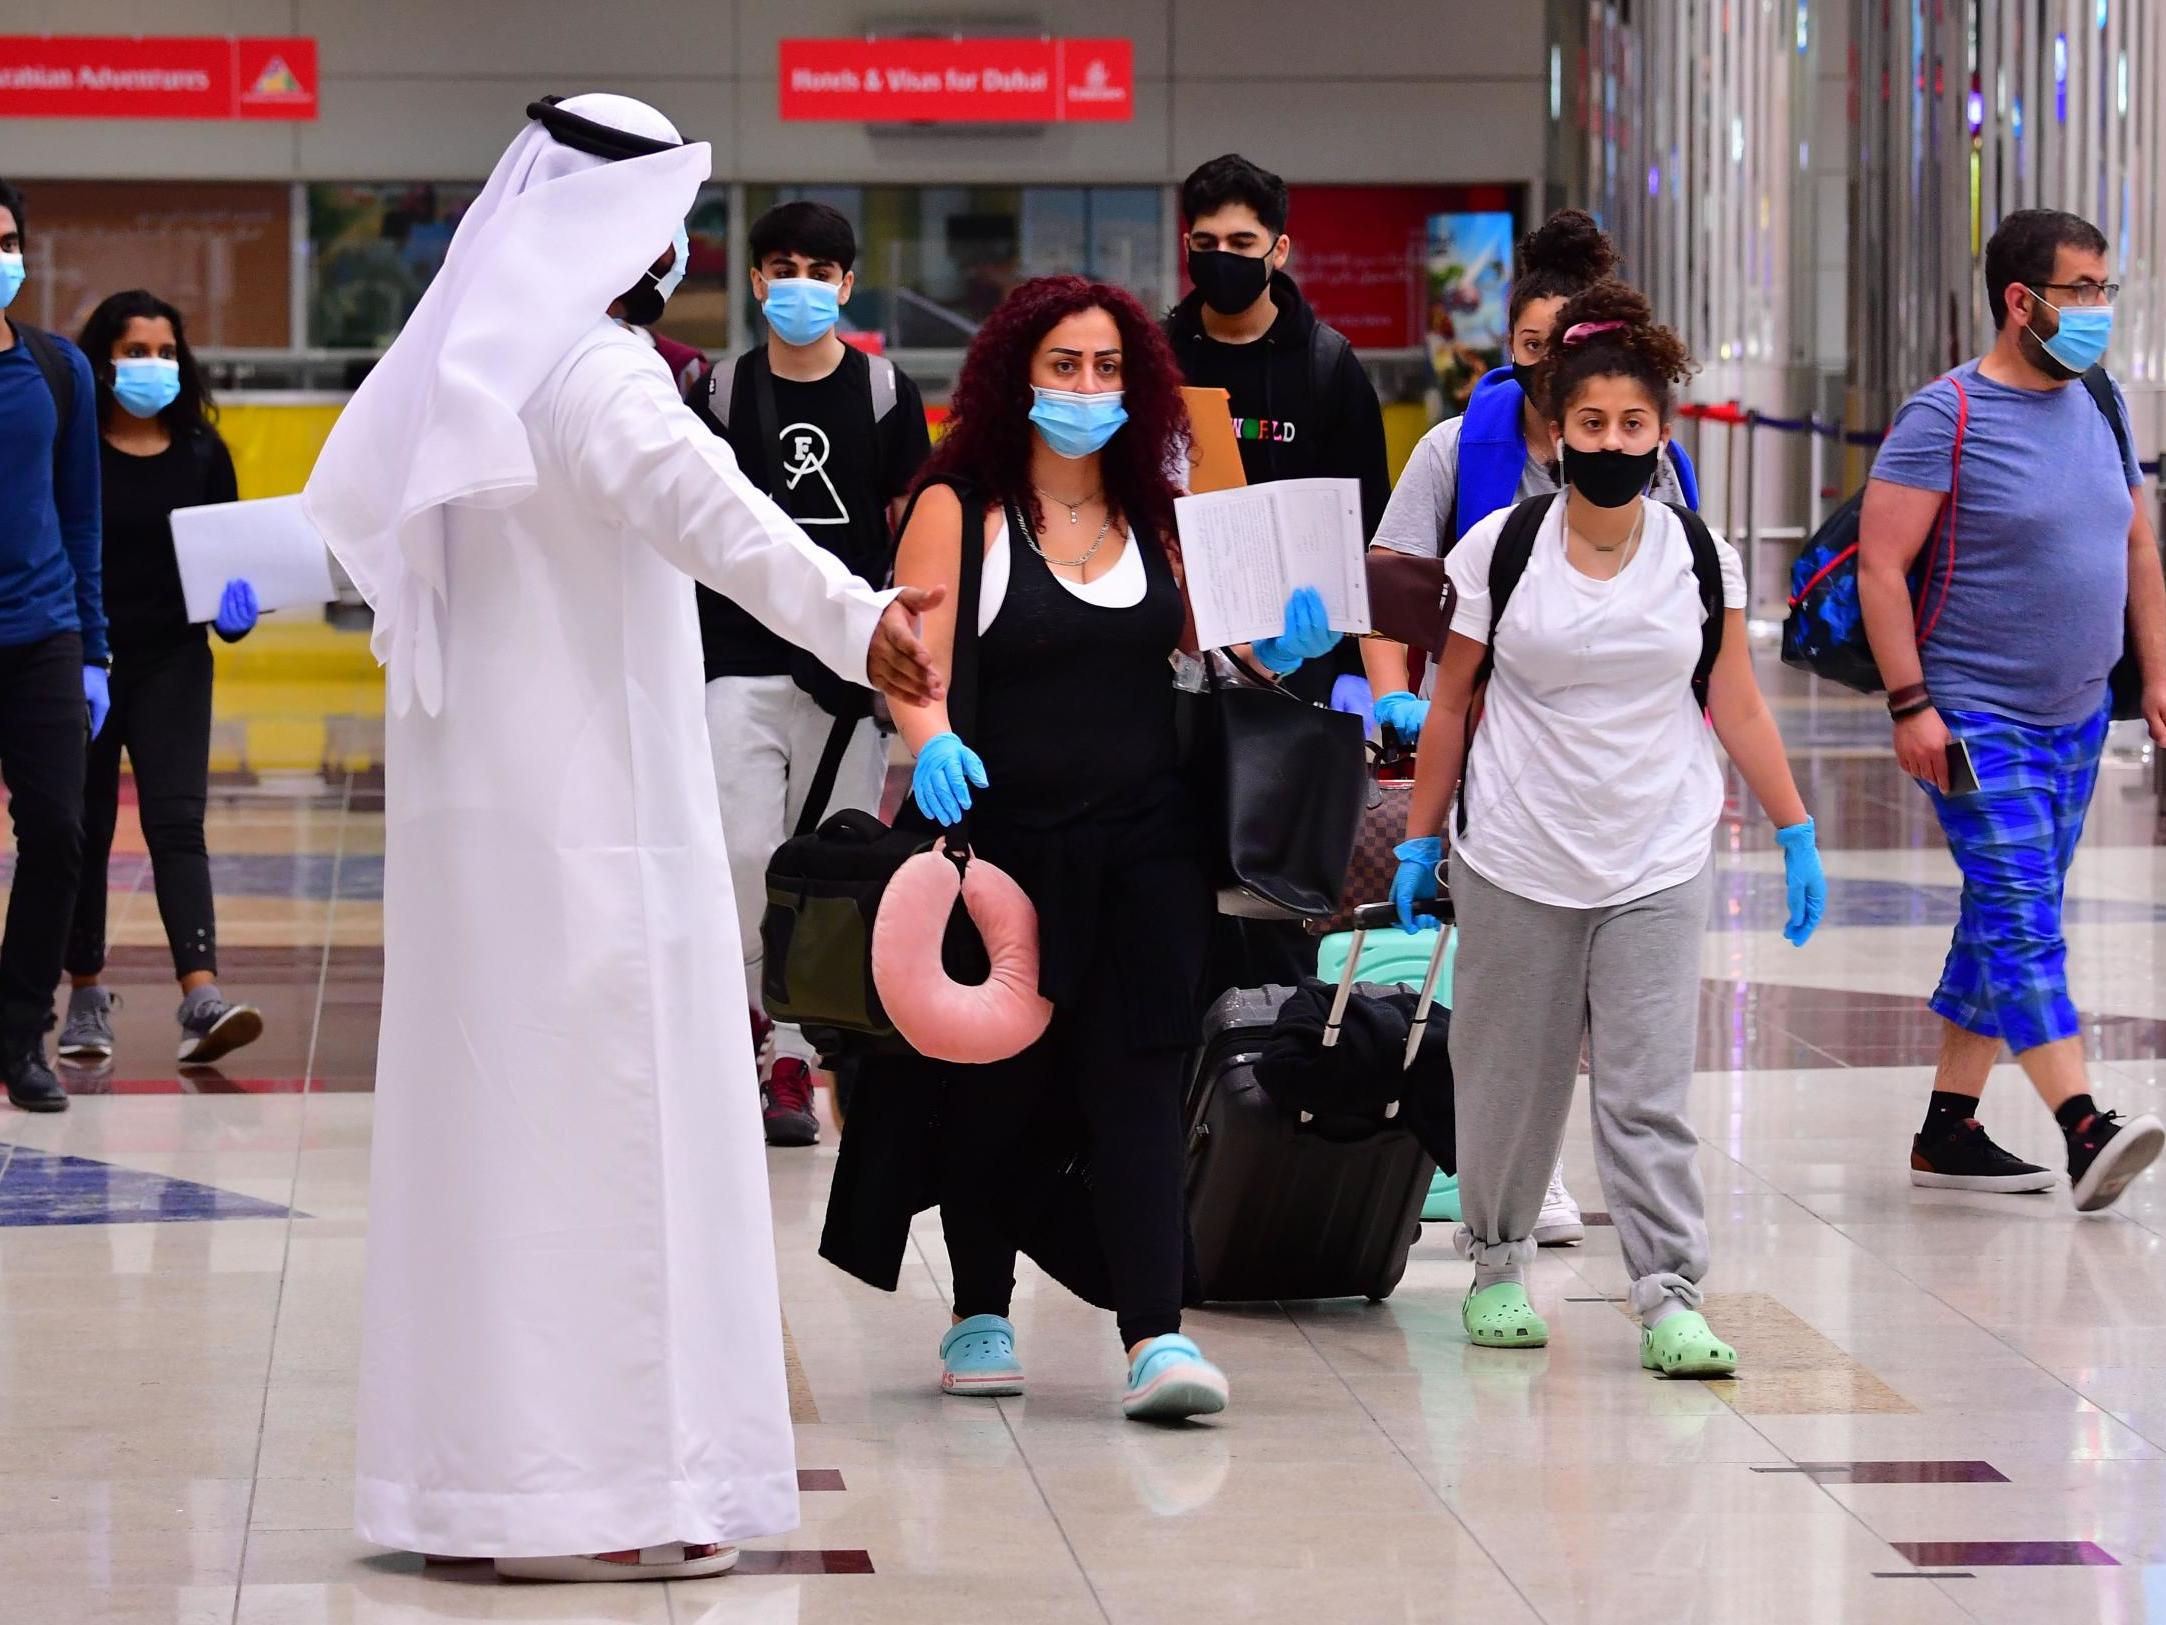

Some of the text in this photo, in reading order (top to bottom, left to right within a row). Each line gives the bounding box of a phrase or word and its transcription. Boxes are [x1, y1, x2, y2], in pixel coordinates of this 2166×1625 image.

[0, 67, 73, 90] rabian
[863, 68, 882, 92] &
[945, 69, 978, 92] for
[982, 69, 1048, 92] Dubai
